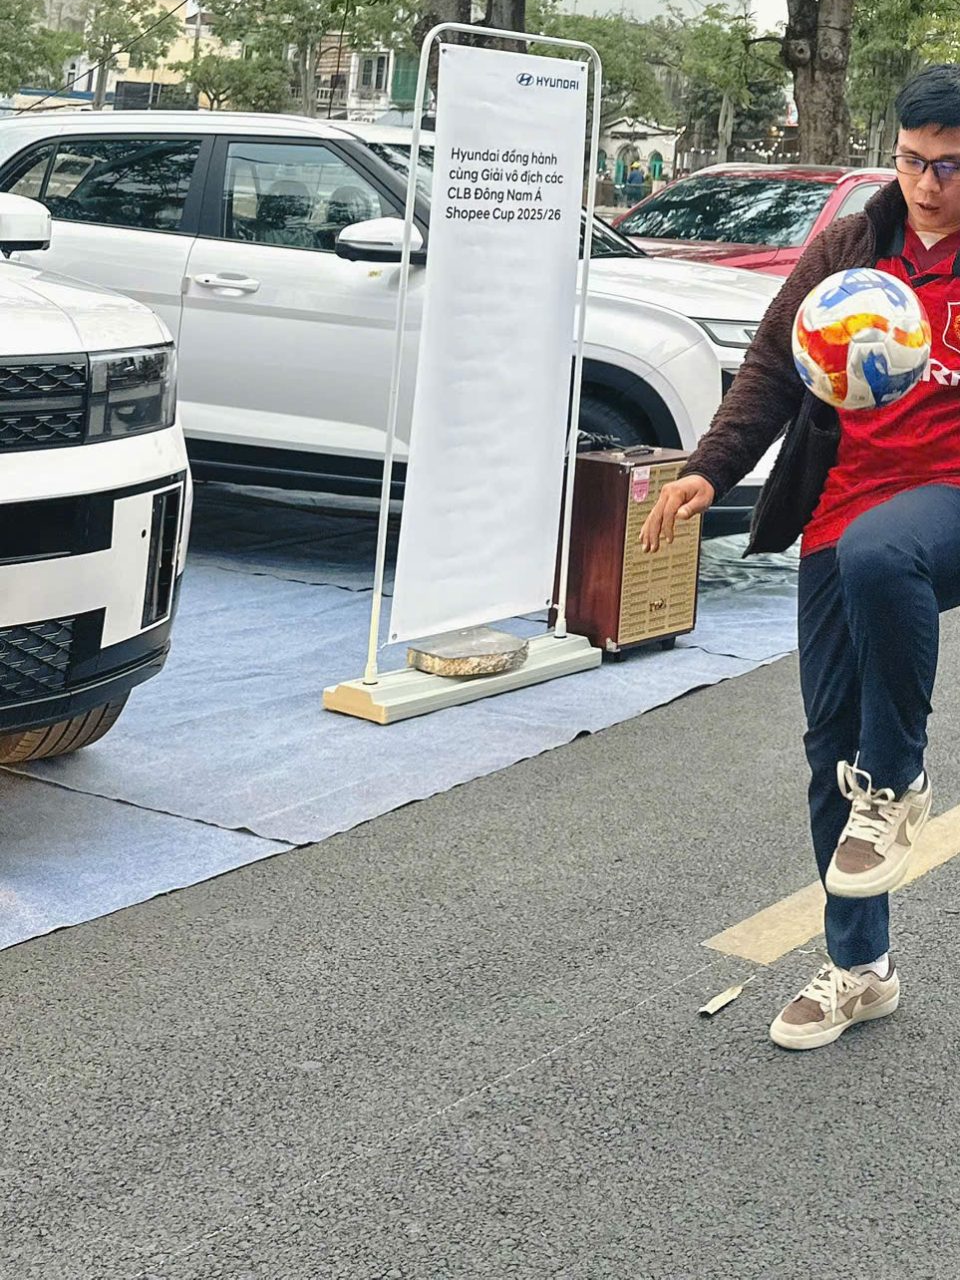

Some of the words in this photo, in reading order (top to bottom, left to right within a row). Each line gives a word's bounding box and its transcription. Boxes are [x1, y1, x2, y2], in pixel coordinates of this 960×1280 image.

[536, 76, 579, 91] HYUNDAI
[451, 147, 500, 163] Hyundai
[531, 151, 558, 165] hành
[449, 166, 479, 183] cùng
[481, 168, 503, 182] Giải
[505, 170, 518, 182] vô
[520, 170, 543, 185] địch
[545, 171, 564, 184] các
[447, 186, 471, 200] CLB
[474, 187, 504, 203] Đông
[506, 189, 533, 201] Nam
[534, 186, 542, 202] Á
[445, 206, 490, 221] Shopee
[492, 207, 515, 222] Cup
[517, 208, 561, 221] 2025/26
